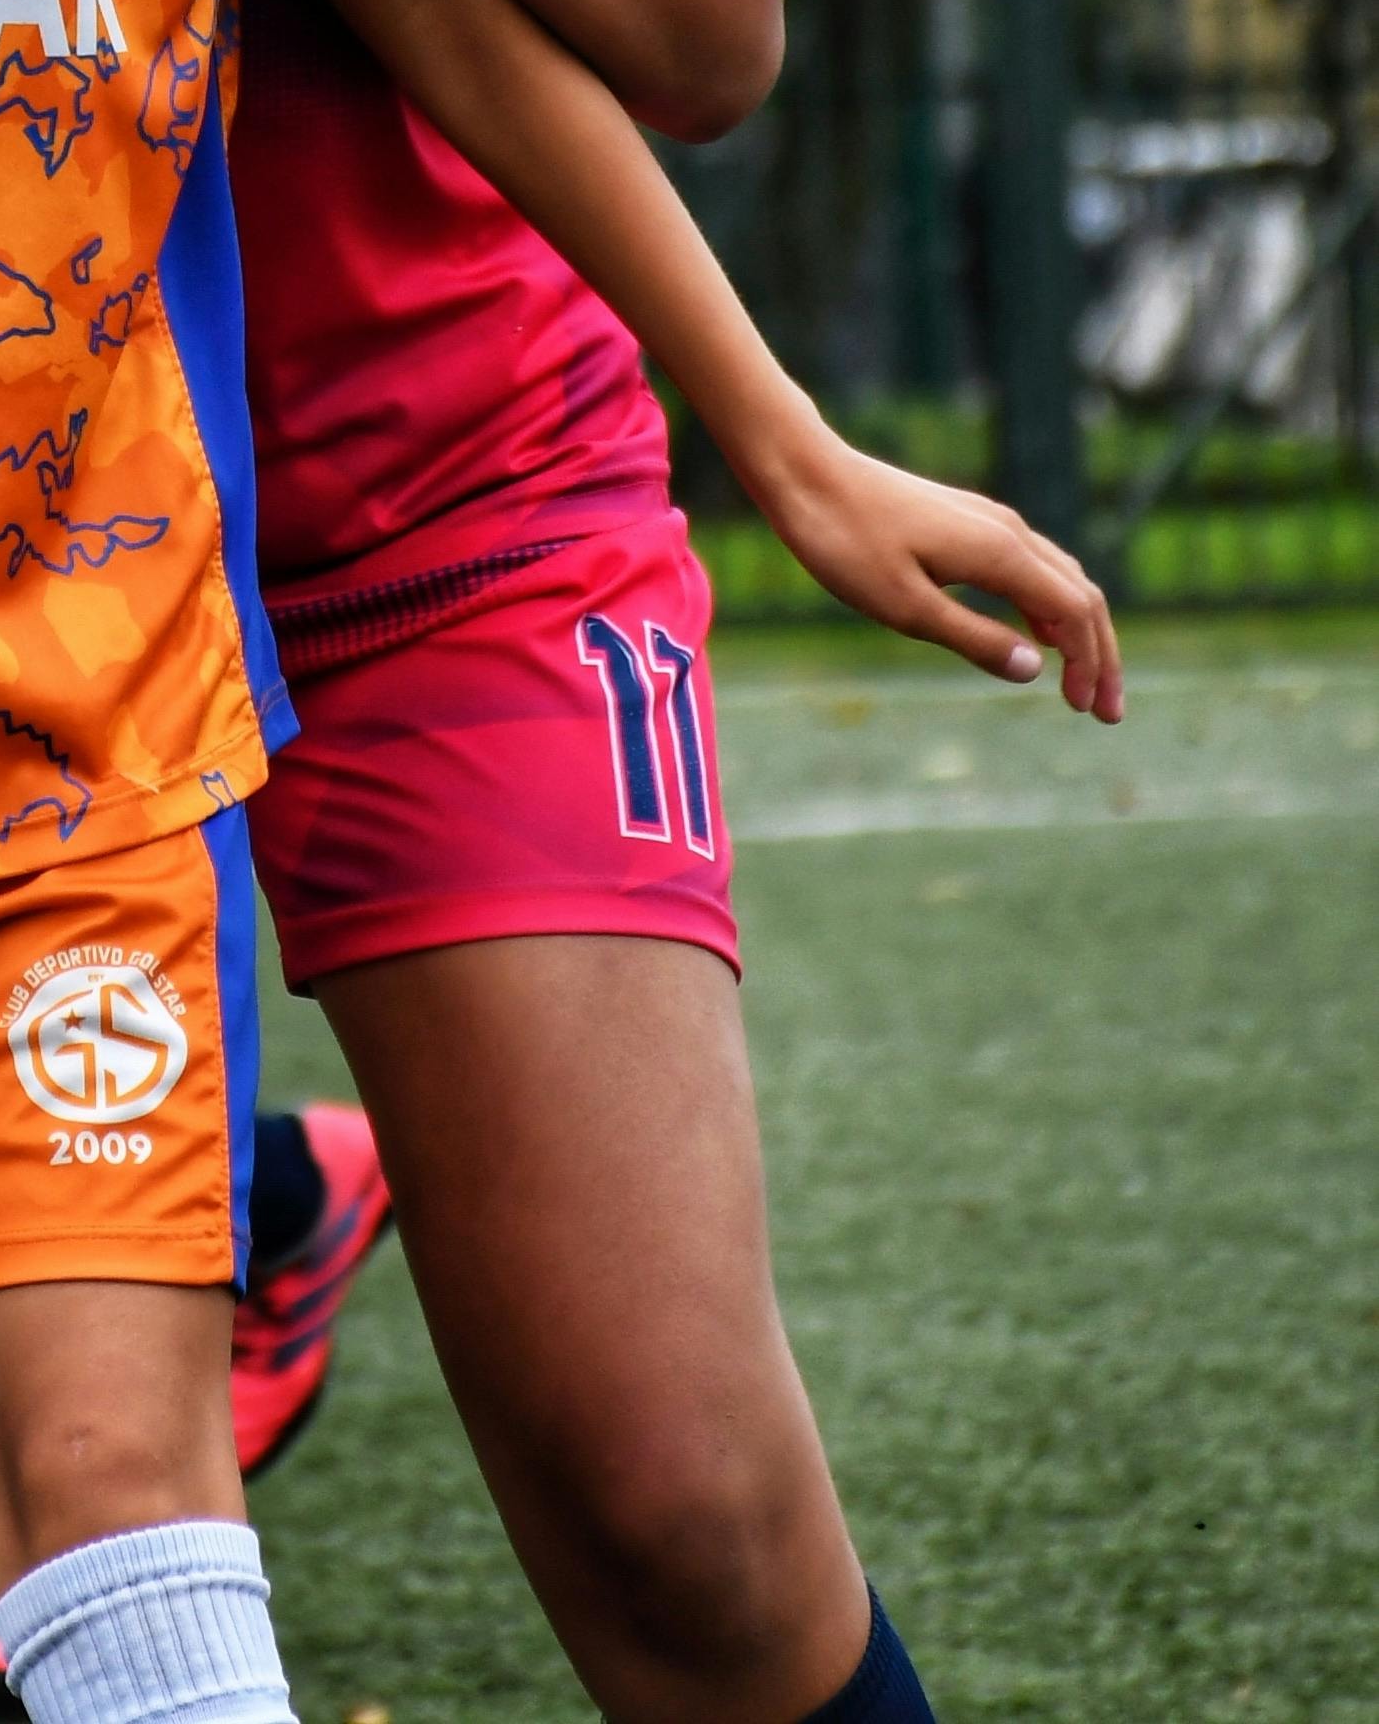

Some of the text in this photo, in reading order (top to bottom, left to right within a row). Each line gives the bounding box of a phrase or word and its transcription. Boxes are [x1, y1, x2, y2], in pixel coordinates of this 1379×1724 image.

[575, 612, 715, 862] 11
[23, 945, 123, 989] DEPORTIVO
[128, 950, 161, 978] GOL
[153, 973, 187, 1018] STAR
[47, 1130, 153, 1166] 2009
